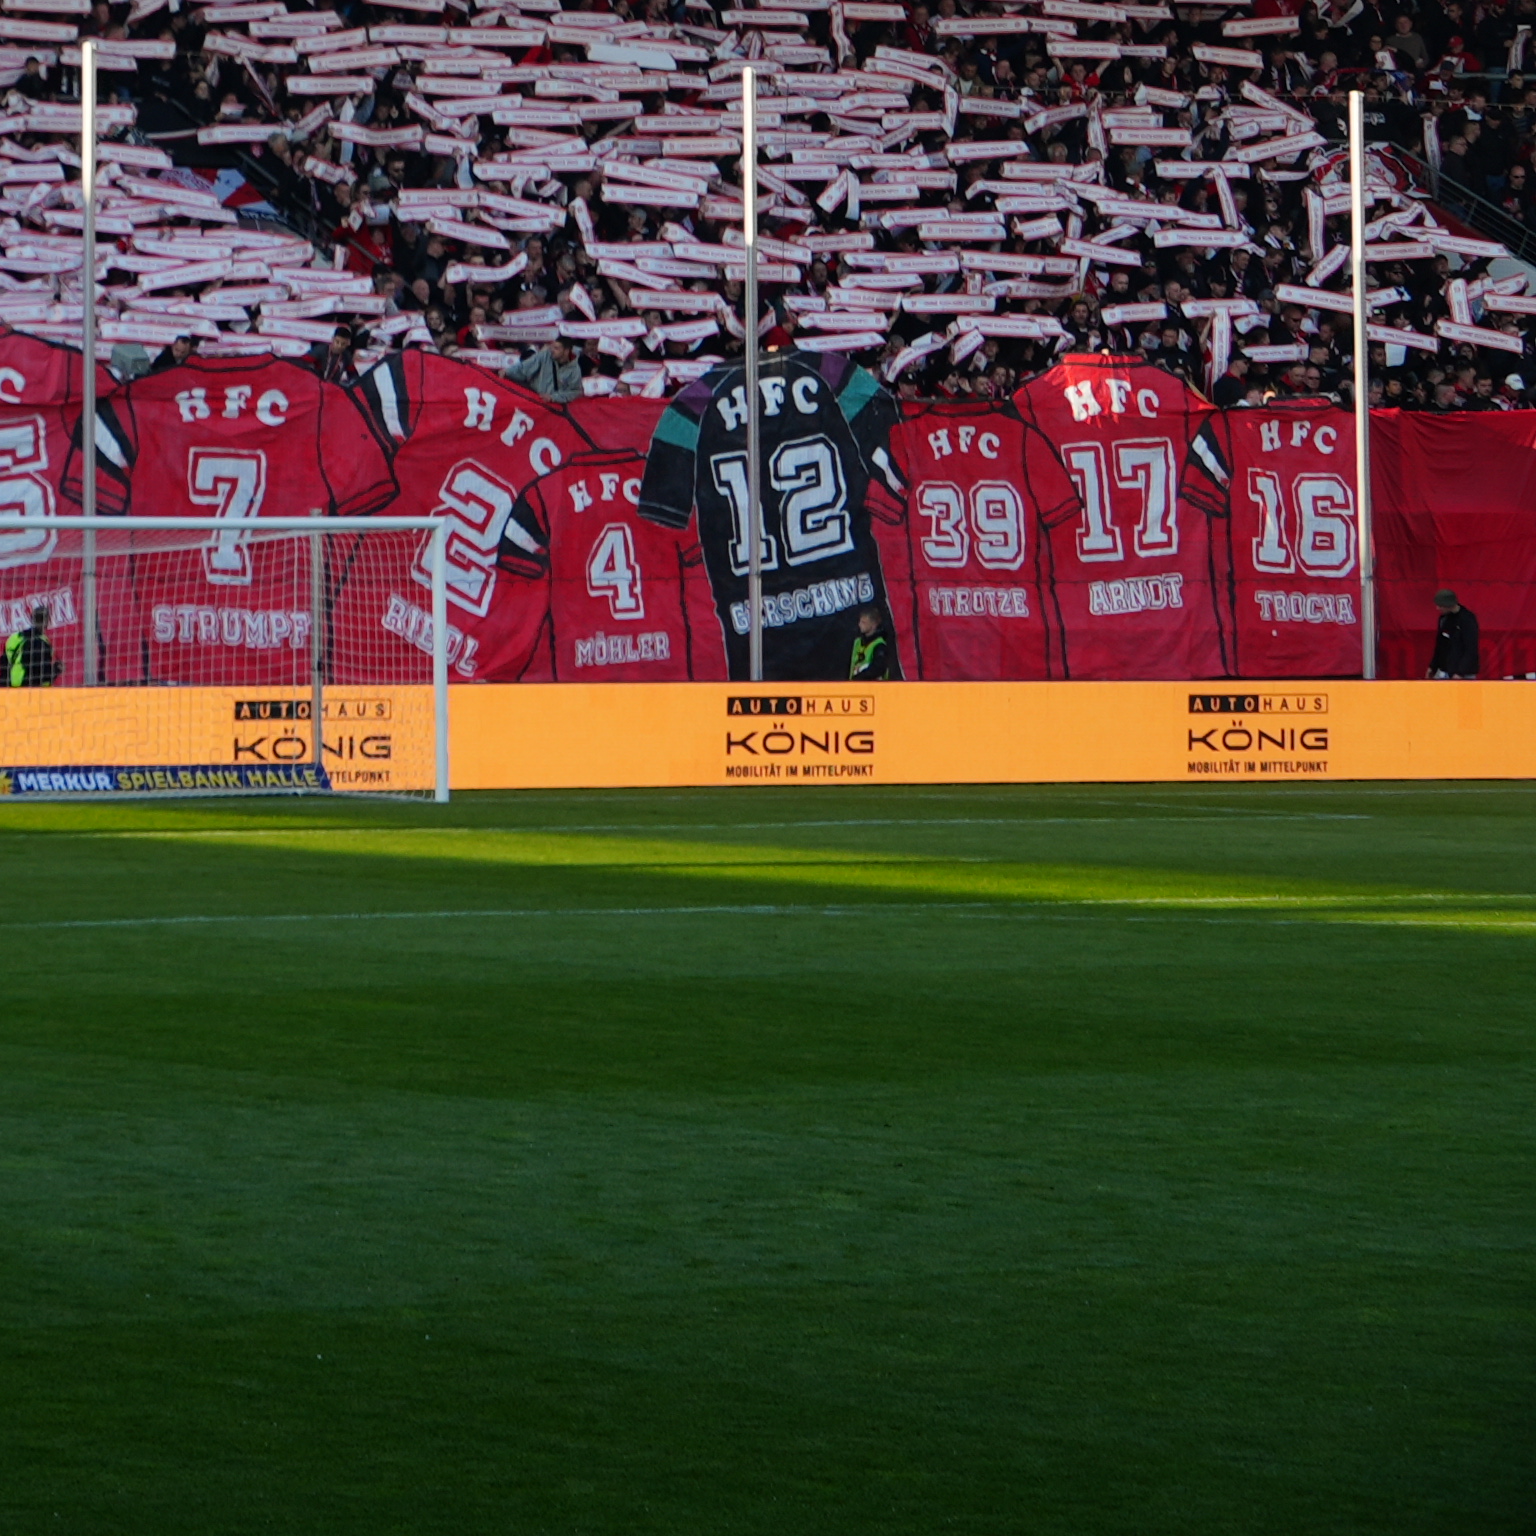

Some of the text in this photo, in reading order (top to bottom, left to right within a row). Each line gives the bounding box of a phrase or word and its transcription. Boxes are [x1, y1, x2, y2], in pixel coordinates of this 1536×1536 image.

[174, 383, 290, 428] HFC
[716, 375, 819, 432] HFC
[1062, 378, 1160, 424] HFC
[462, 386, 563, 476] HFC
[927, 424, 1002, 461] HFC
[1259, 419, 1338, 456] HFC
[568, 472, 640, 514] HFC
[710, 432, 856, 578] 12
[1060, 435, 1179, 565] 17
[187, 445, 267, 586] 7
[914, 479, 1026, 572] 39
[1246, 466, 1357, 579] 16
[411, 457, 520, 618] 2
[585, 521, 645, 621] 4
[1088, 572, 1185, 617] ARNDT
[1254, 589, 1356, 625] TROCHA
[151, 604, 313, 649] STRUMPF
[574, 630, 672, 669] MÖHLER
[731, 698, 869, 714] AUTOHAUS
[1192, 696, 1323, 712] AUTOHAUS
[234, 728, 392, 761] KÖNIG
[726, 721, 874, 756] KÖNIG
[1187, 719, 1329, 752] KÖNIG
[17, 766, 322, 793] MERKUR SPIELBANK HALLE
[329, 770, 391, 784] TTELPUNKT
[725, 763, 874, 778] MOBILITÄT IM MITTELPUNKT
[1187, 759, 1329, 774] MOBILITÄT IM MITTELPUNKT
